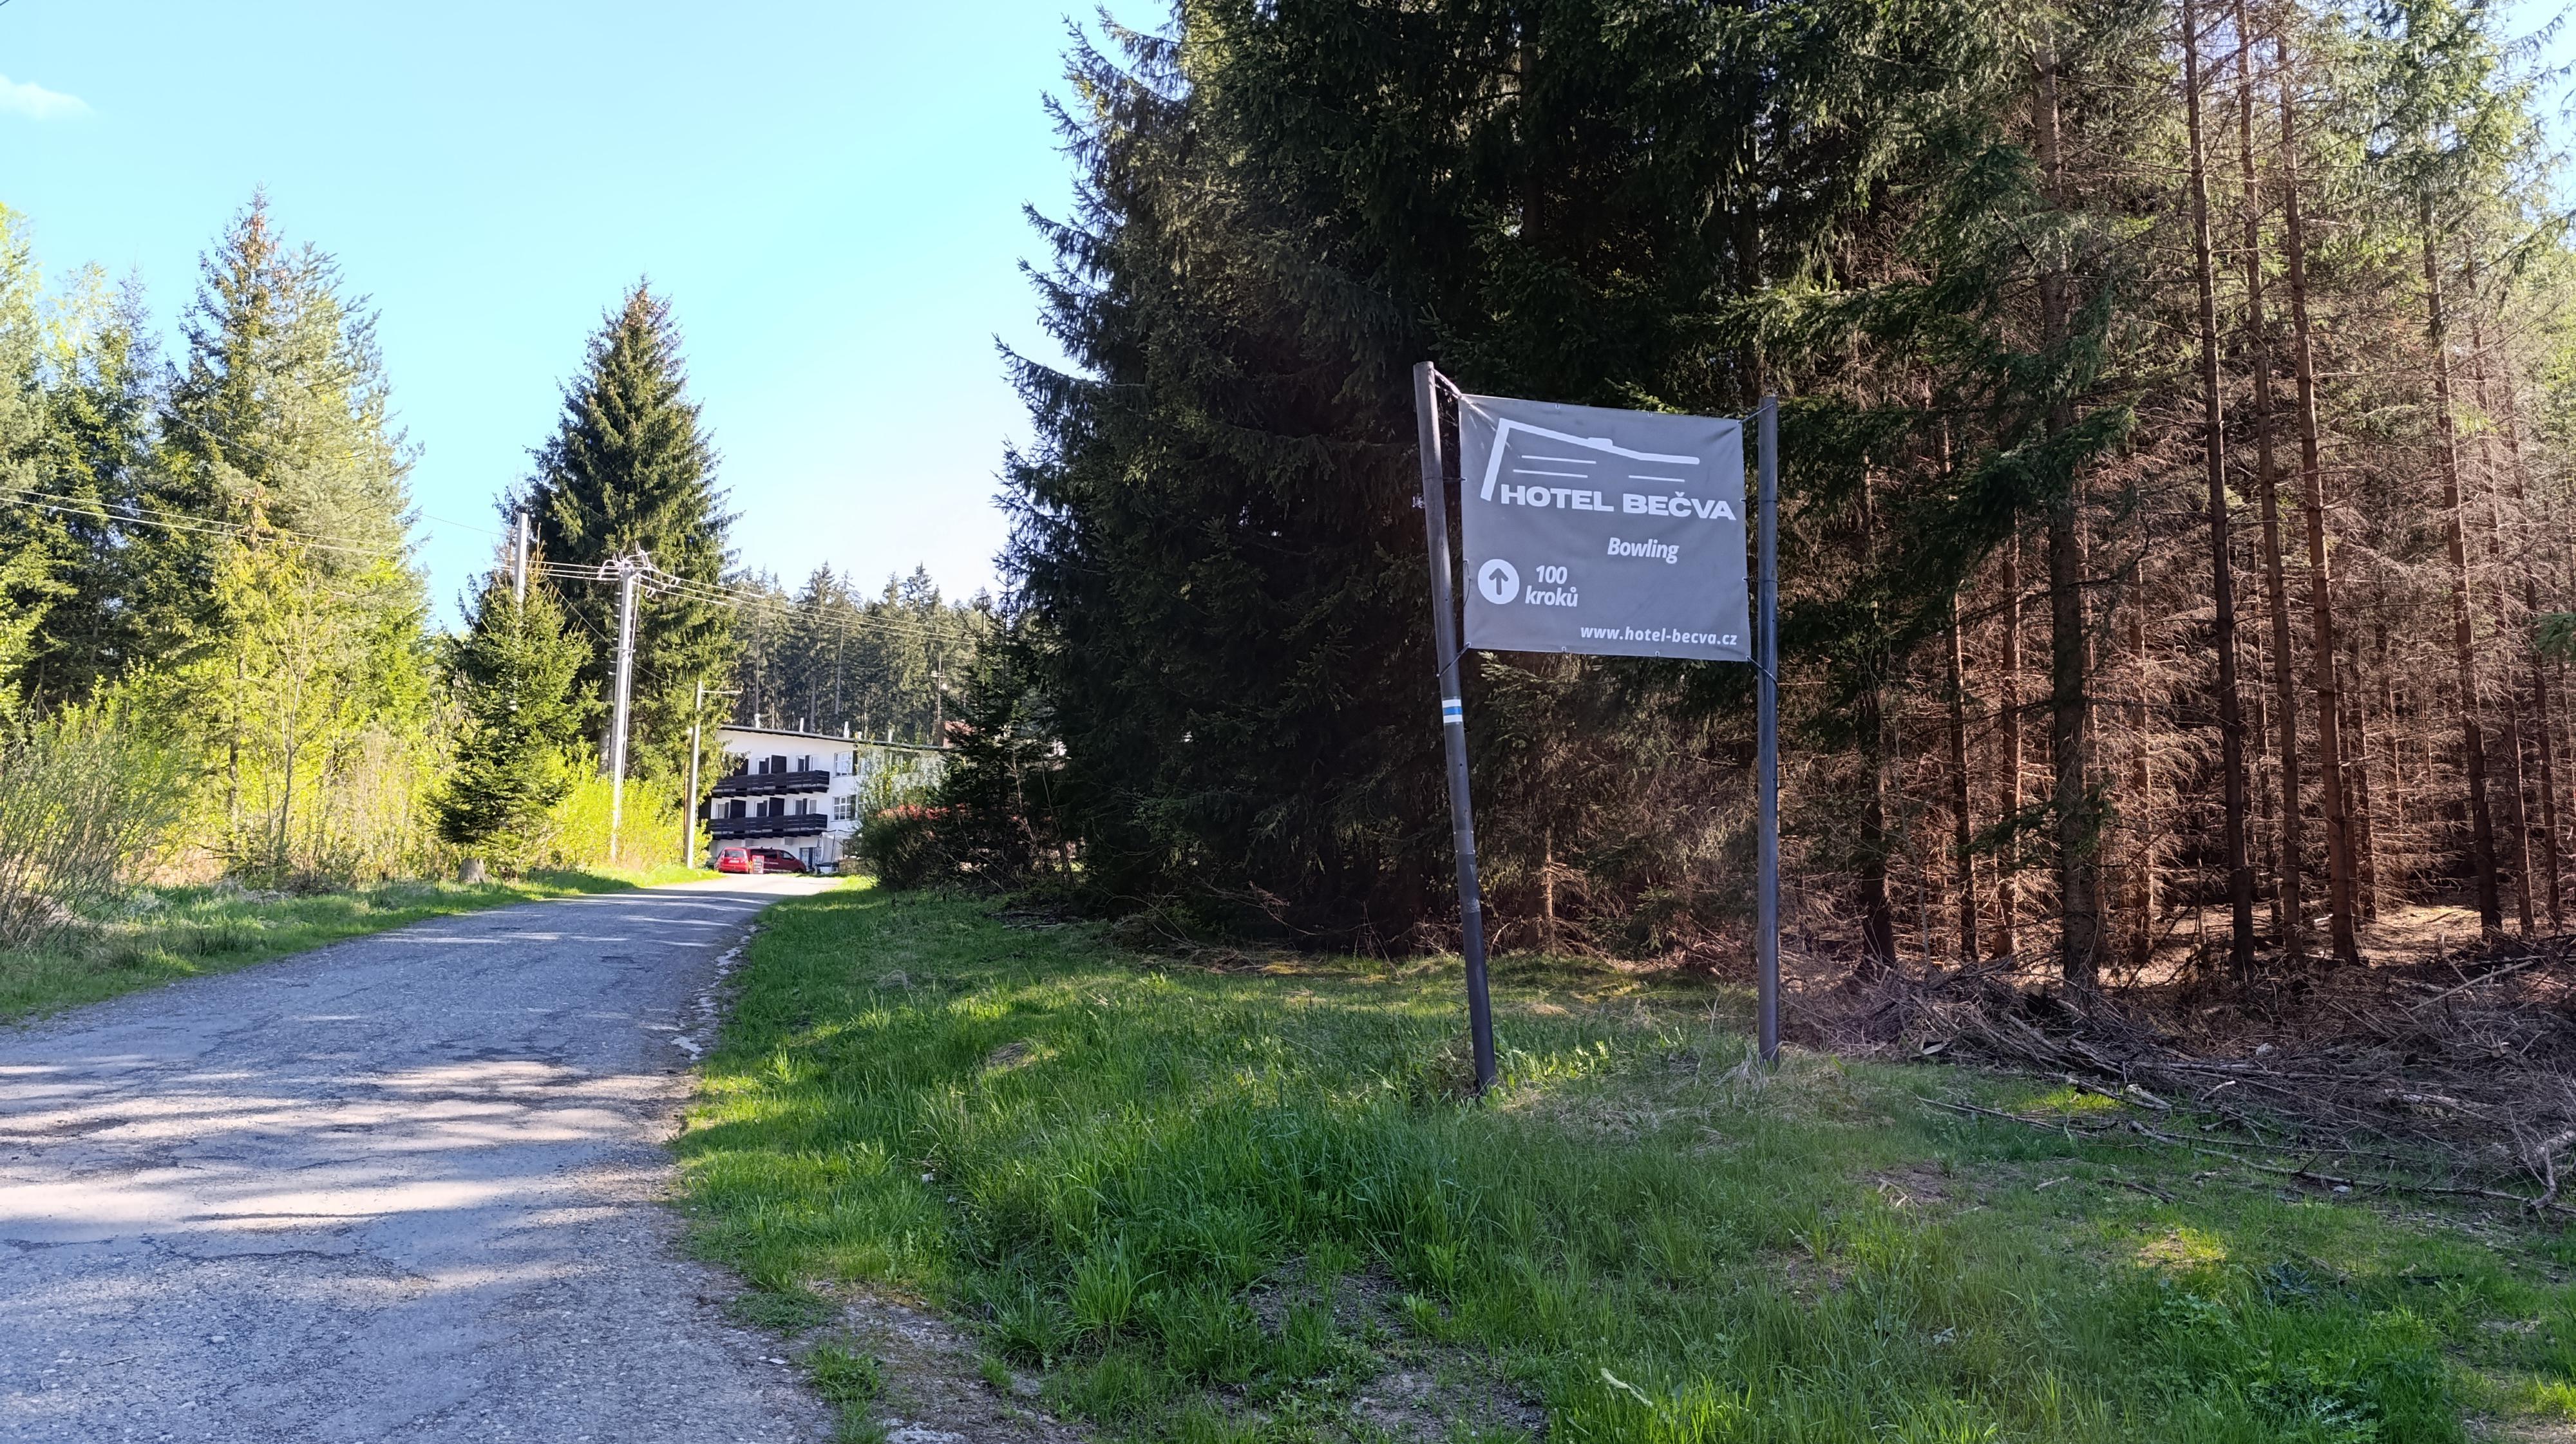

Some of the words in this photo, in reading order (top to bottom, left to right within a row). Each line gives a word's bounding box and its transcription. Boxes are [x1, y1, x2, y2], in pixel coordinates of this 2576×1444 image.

[1501, 484, 1614, 512] HOTEL
[1622, 491, 1736, 520] BEČVA
[1607, 538, 1679, 564] Bowling
[1535, 565, 1567, 585] 100
[1525, 586, 1578, 607] kroků
[1580, 626, 1738, 646] www.hotel-becva.cz
